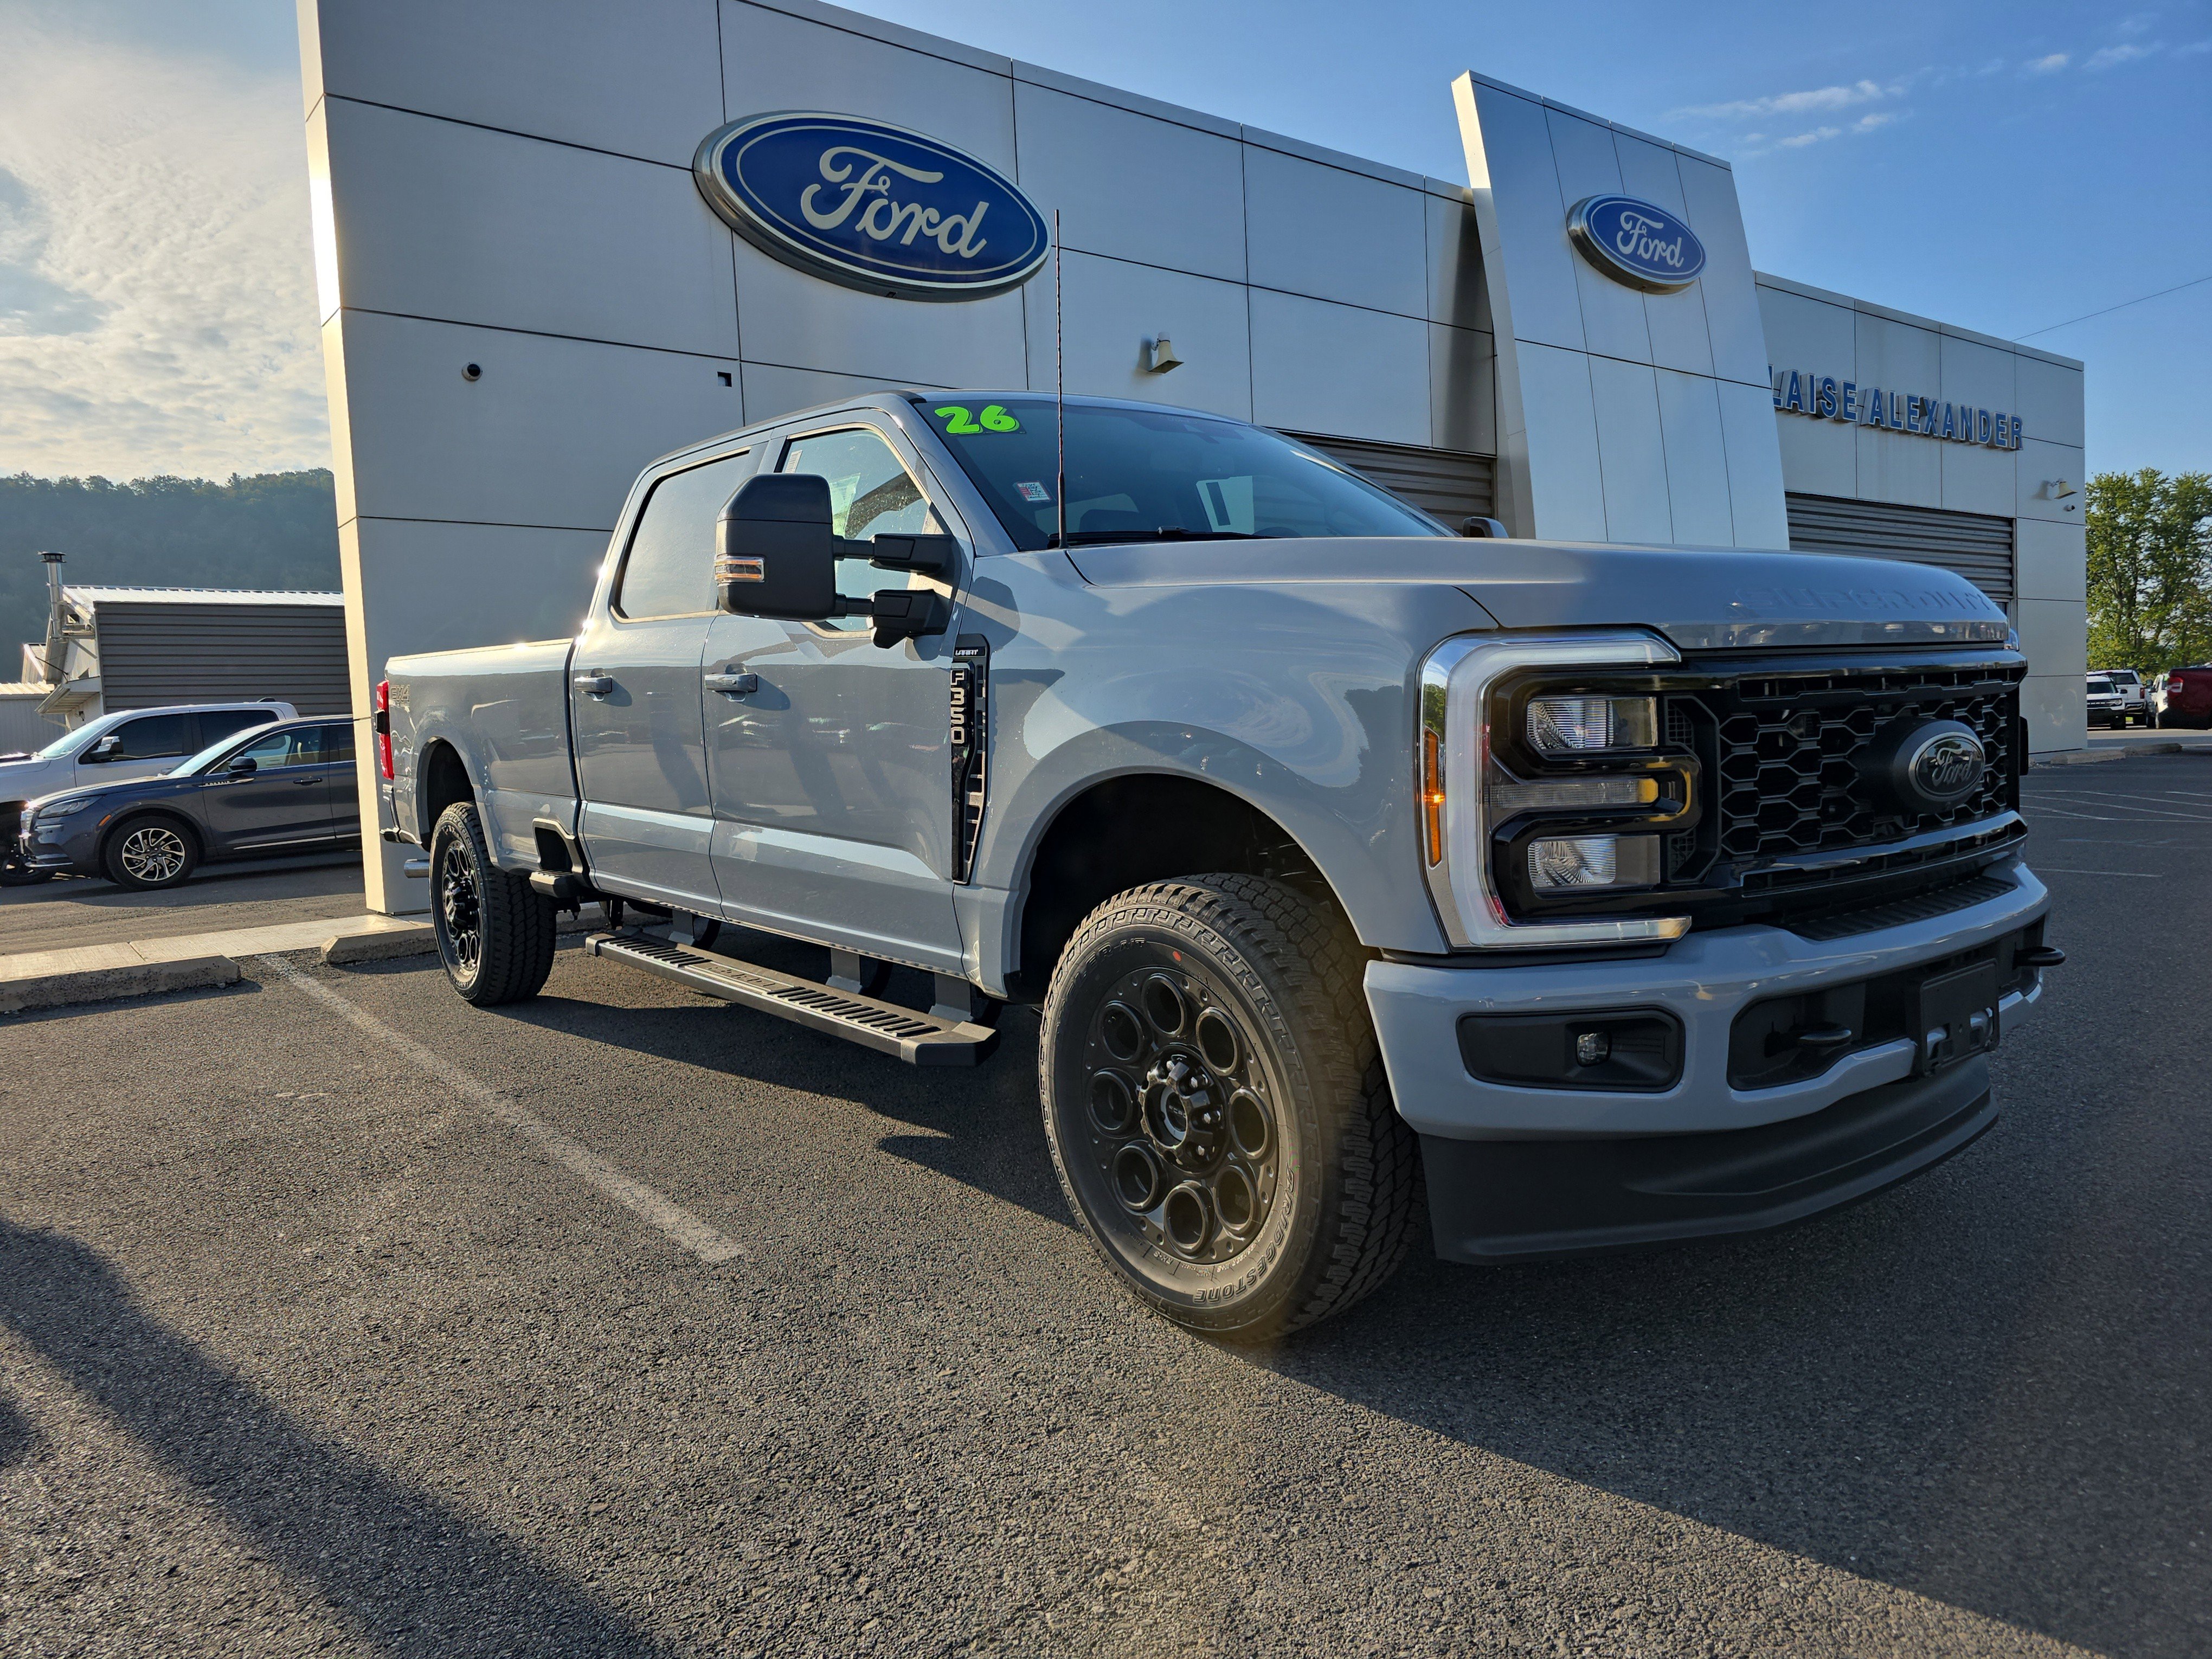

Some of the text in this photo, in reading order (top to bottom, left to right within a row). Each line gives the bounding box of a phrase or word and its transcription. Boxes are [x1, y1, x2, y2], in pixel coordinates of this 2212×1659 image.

[800, 146, 989, 259] Ford
[1616, 211, 1684, 268] Ford
[934, 404, 1020, 434] 26
[1863, 387, 2023, 450] ALEXANDER
[1931, 747, 1973, 787] Ford
[1193, 1162, 1295, 1303] BRIDGESTONE
